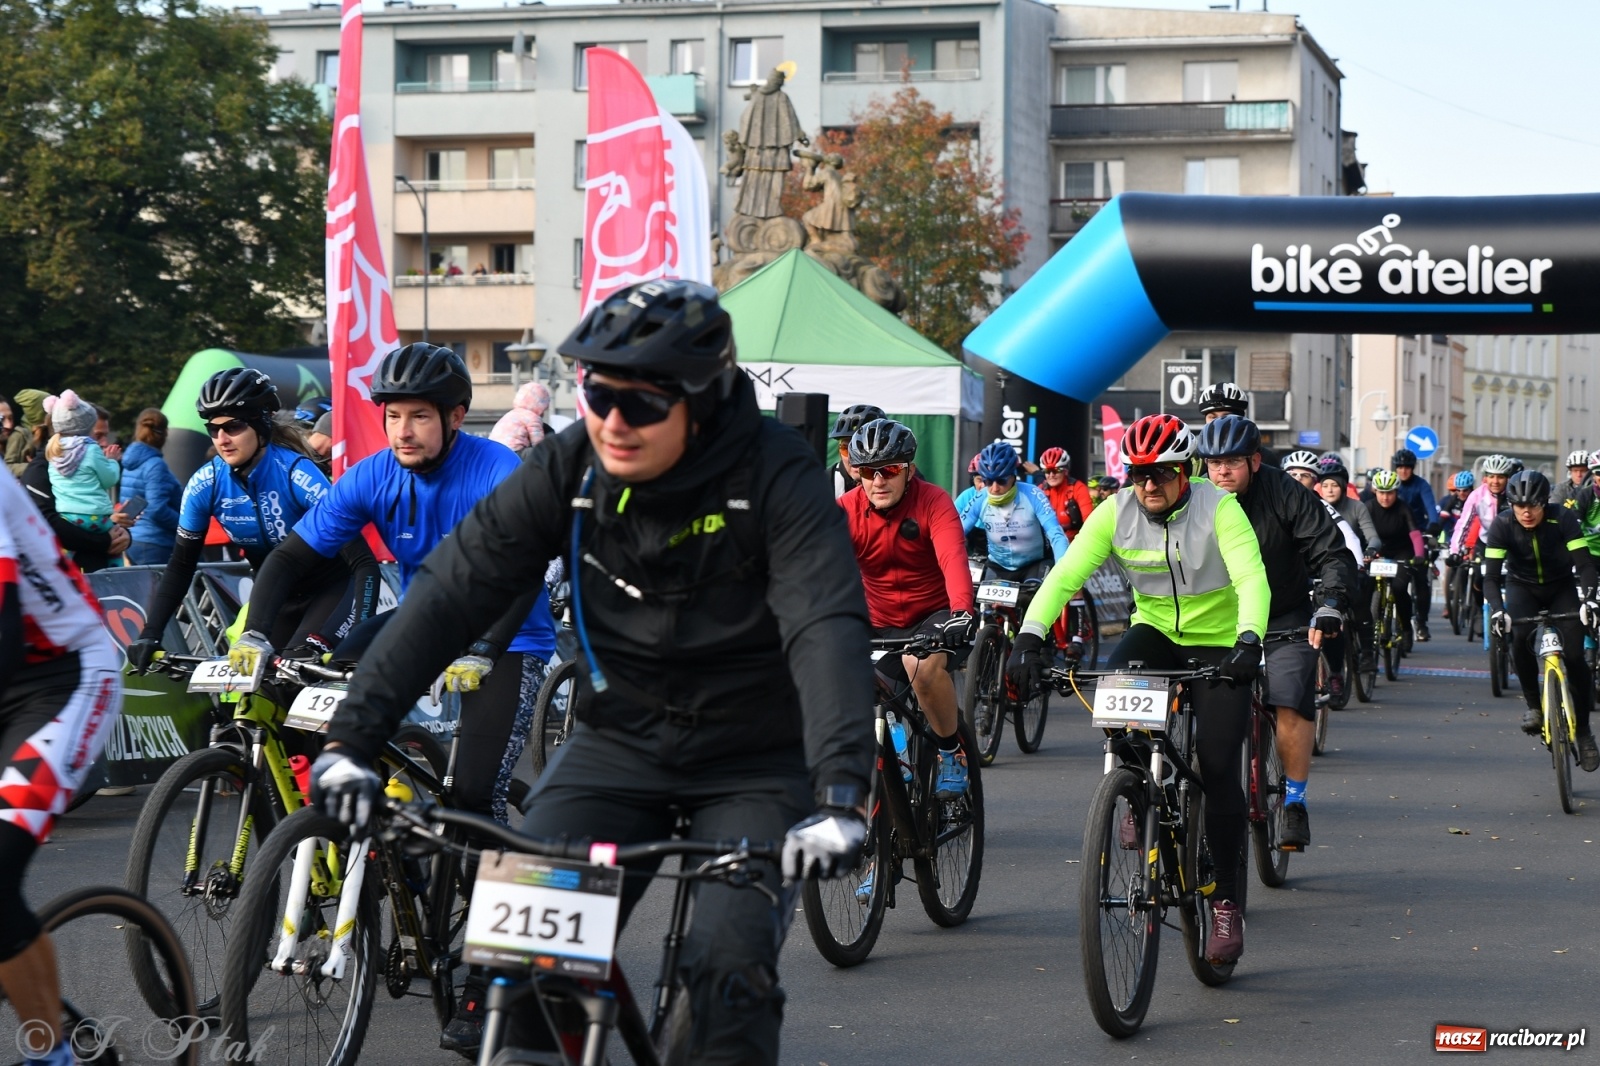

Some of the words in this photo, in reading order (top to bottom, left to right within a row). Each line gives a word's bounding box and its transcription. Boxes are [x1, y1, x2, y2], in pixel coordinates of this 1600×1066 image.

[1251, 243, 1362, 294] bike
[1378, 245, 1553, 295] atelier
[1170, 374, 1193, 405] 0
[985, 588, 1012, 598] 1939
[1105, 694, 1154, 713] 3192
[489, 901, 585, 945] 2151
